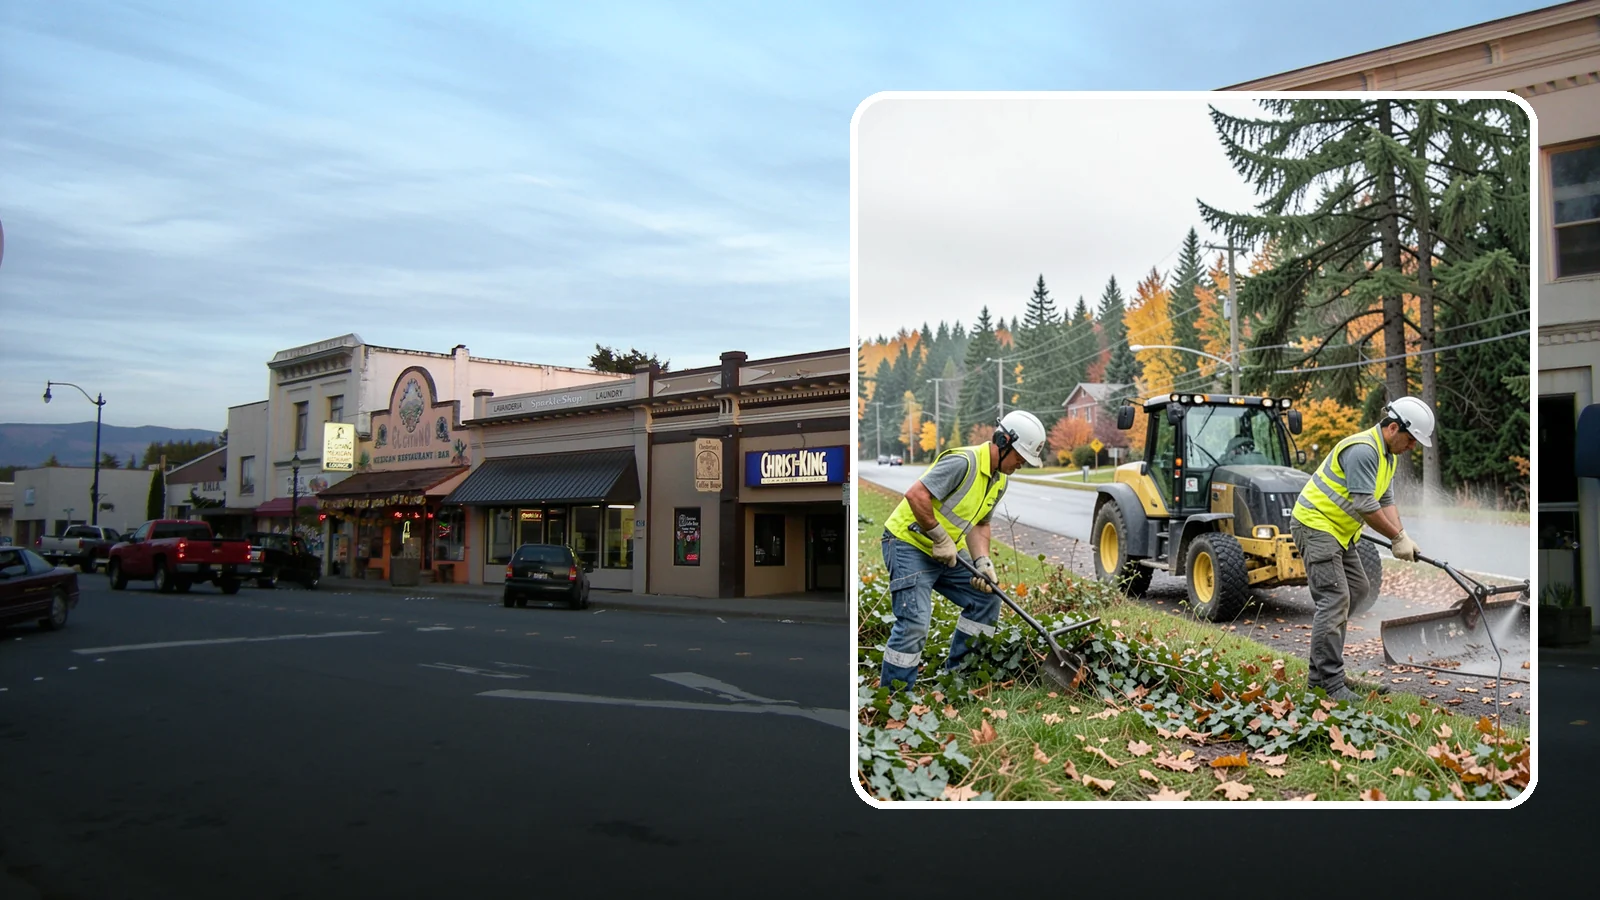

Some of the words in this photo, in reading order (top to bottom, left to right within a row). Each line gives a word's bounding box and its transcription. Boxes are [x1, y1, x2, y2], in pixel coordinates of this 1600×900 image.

[595, 389, 623, 400] LAUNDRY
[493, 402, 523, 412] LAVANDERIA
[531, 397, 561, 408] Sparkle
[562, 395, 582, 405] Shop
[373, 454, 398, 464] MEXICAN
[398, 451, 433, 462] RESTAURANT
[438, 450, 450, 459] BAR
[761, 452, 797, 478] CHRIST
[799, 450, 827, 476] KING
